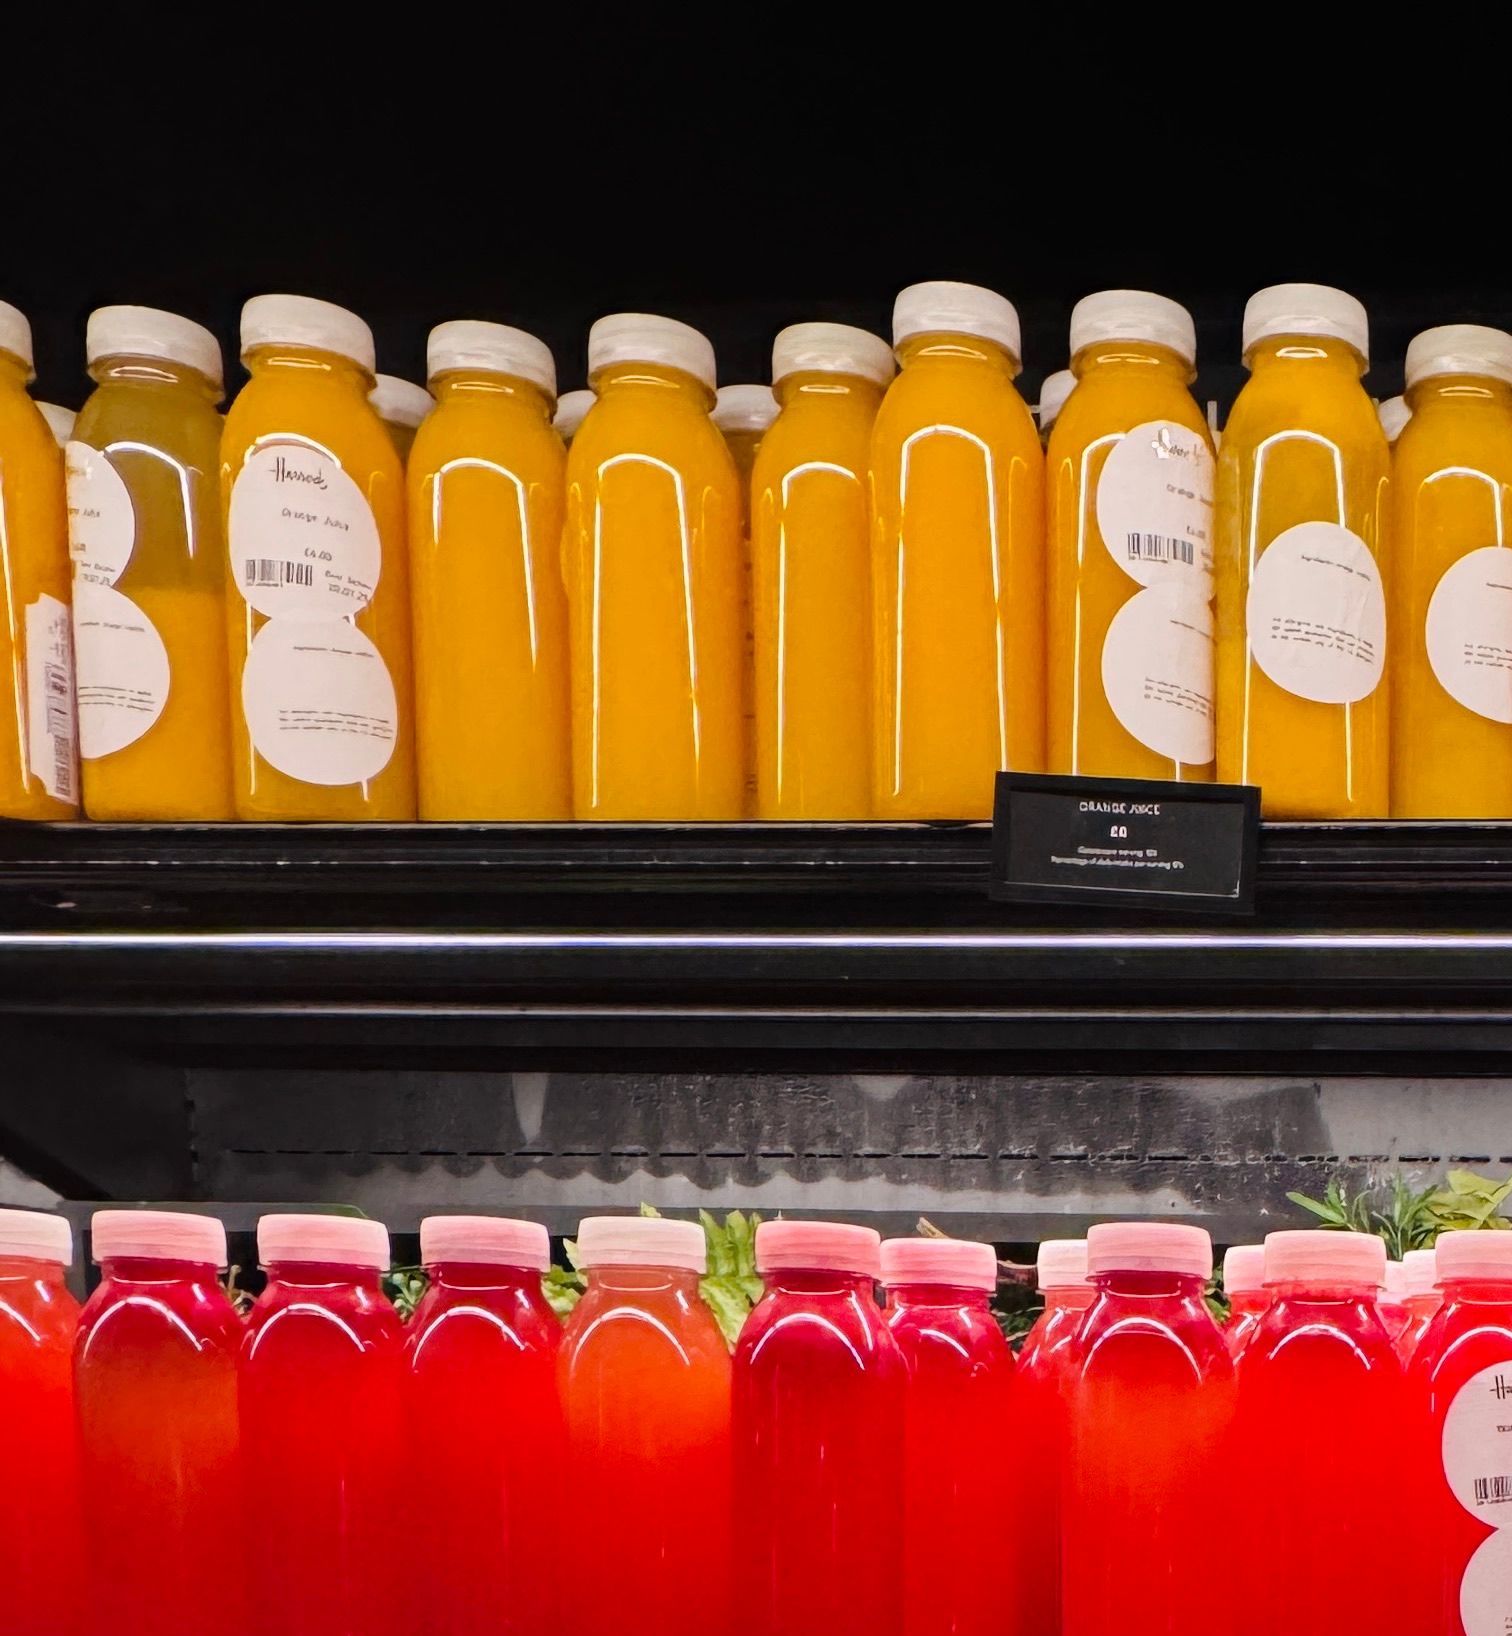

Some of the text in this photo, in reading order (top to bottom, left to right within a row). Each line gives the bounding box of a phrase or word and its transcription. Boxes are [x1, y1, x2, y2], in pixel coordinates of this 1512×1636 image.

[268, 456, 328, 490] Harrods
[1079, 801, 1161, 815] ORANGE JUICE
